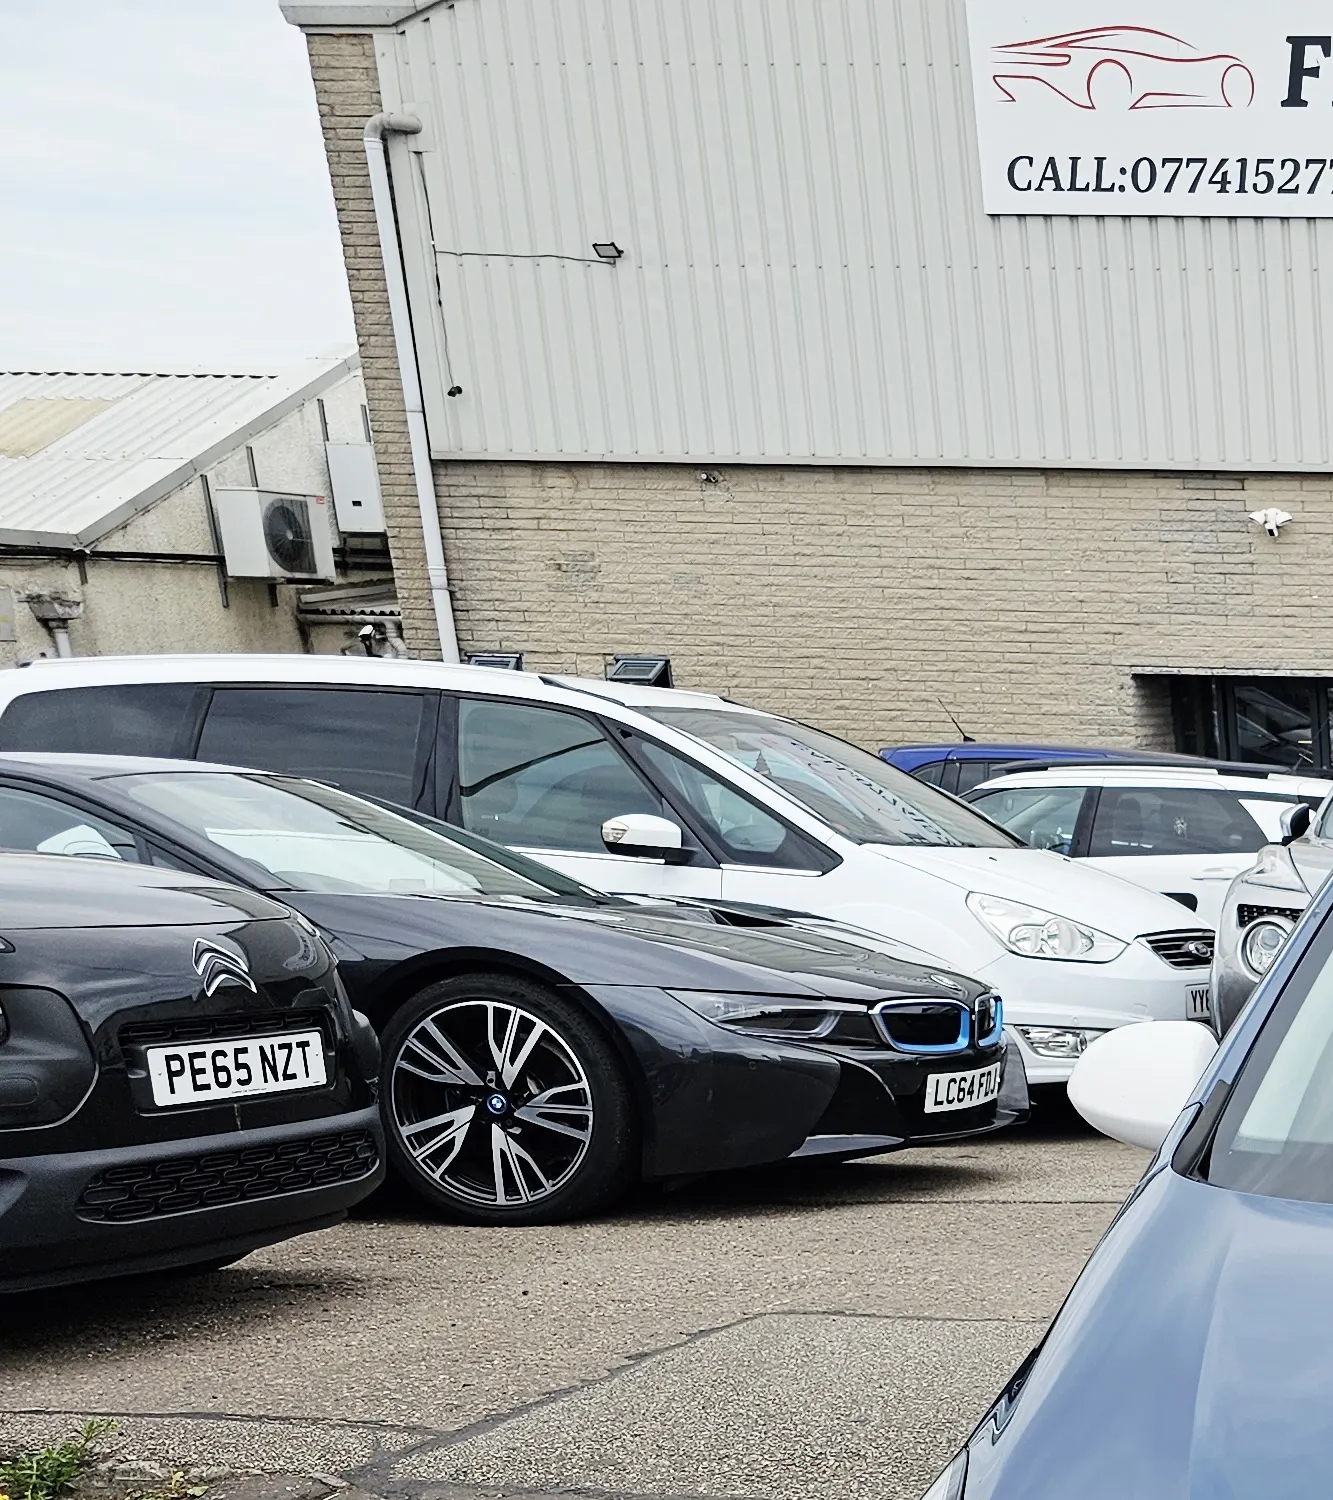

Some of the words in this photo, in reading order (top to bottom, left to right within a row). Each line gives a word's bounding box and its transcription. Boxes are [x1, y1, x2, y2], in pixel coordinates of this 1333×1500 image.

[165, 1048, 252, 1094] PE65
[259, 1040, 310, 1083] NZT
[934, 1075, 975, 1106] LC64
